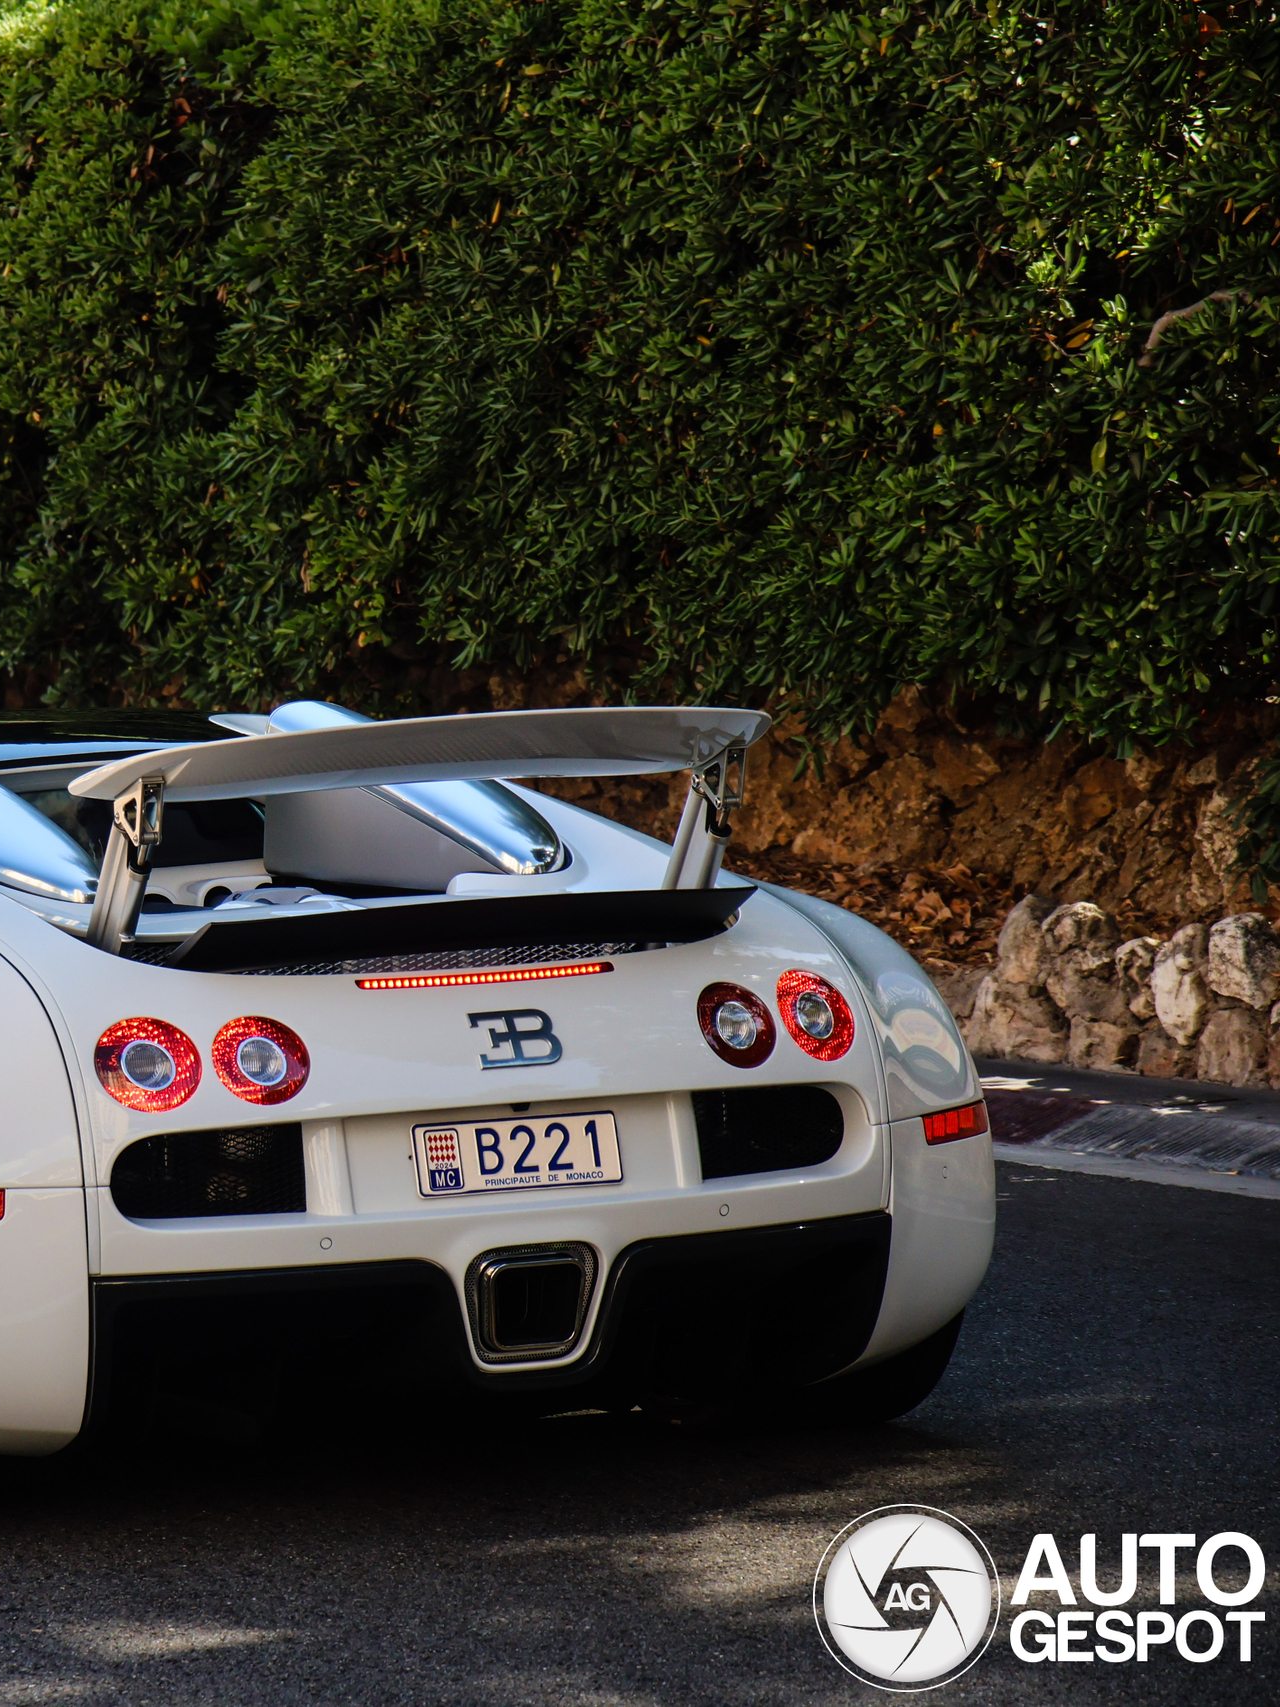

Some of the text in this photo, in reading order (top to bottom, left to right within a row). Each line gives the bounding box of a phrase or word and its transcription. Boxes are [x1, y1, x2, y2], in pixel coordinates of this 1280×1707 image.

[475, 1119, 602, 1175] B221
[435, 1162, 454, 1170] 2024
[435, 1171, 456, 1188] MC
[485, 1171, 604, 1187] PRINCIPAUTE DE MONACO
